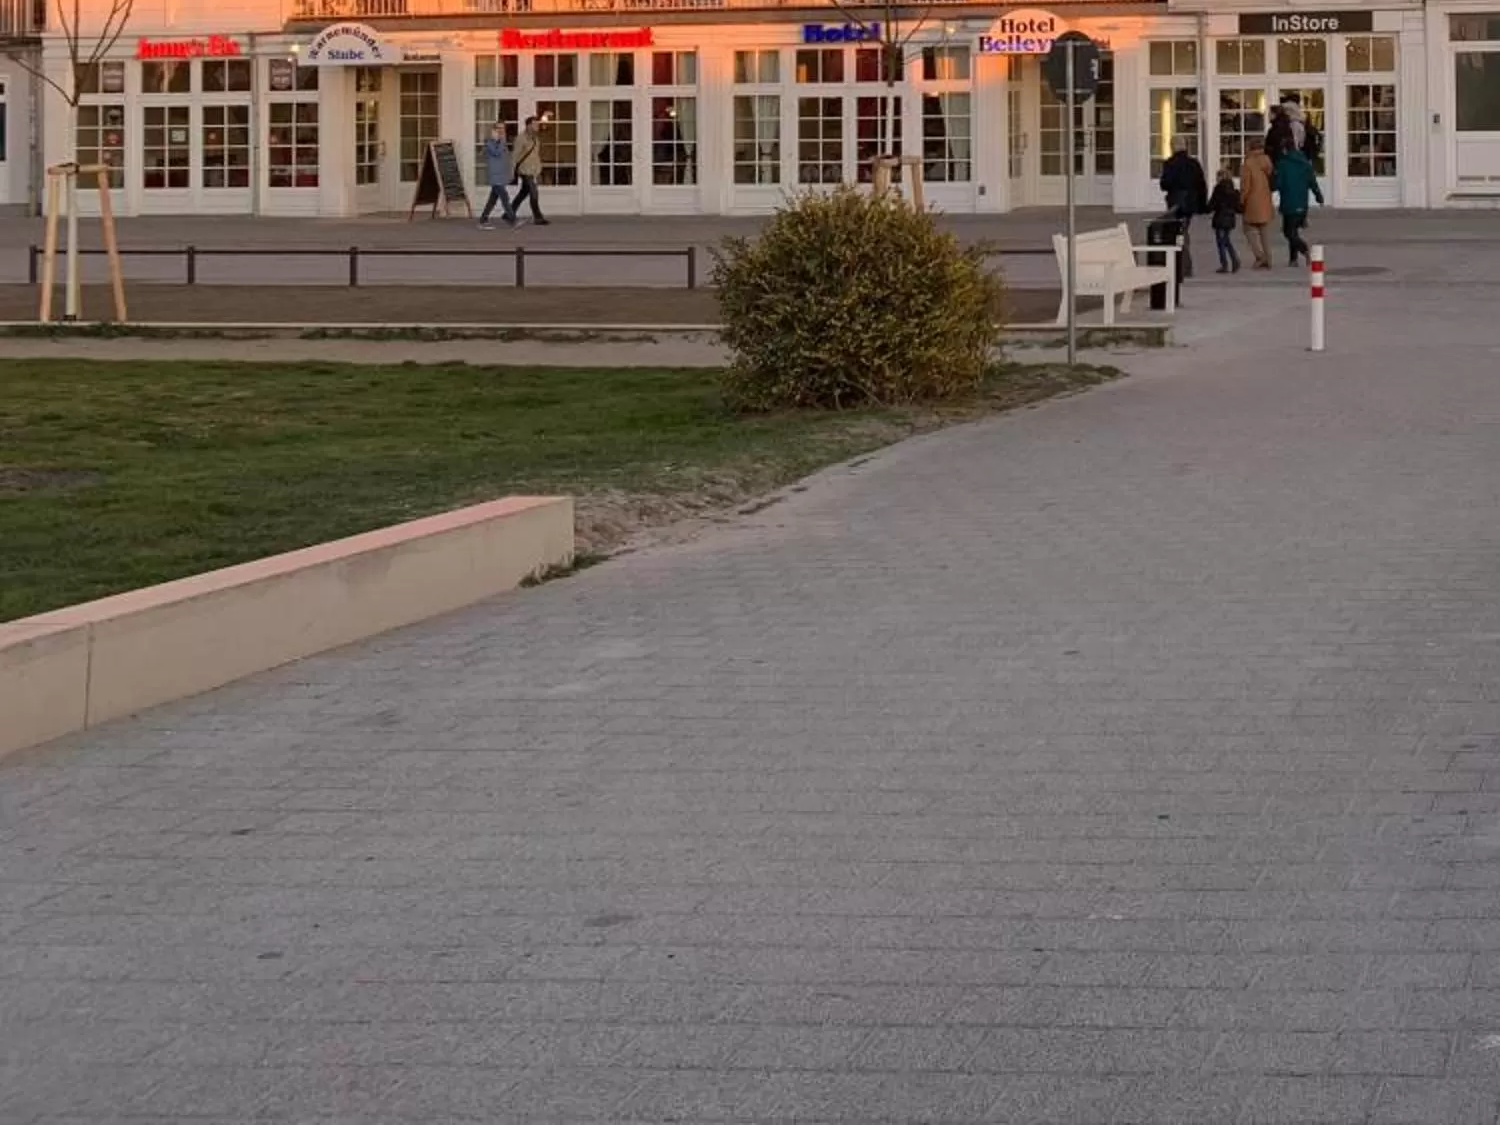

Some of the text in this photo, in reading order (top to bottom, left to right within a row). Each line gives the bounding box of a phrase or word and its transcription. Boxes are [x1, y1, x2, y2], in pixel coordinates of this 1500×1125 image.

[1000, 18, 1055, 33] Hotel
[1271, 15, 1339, 31] InStore
[327, 49, 365, 60] Stube
